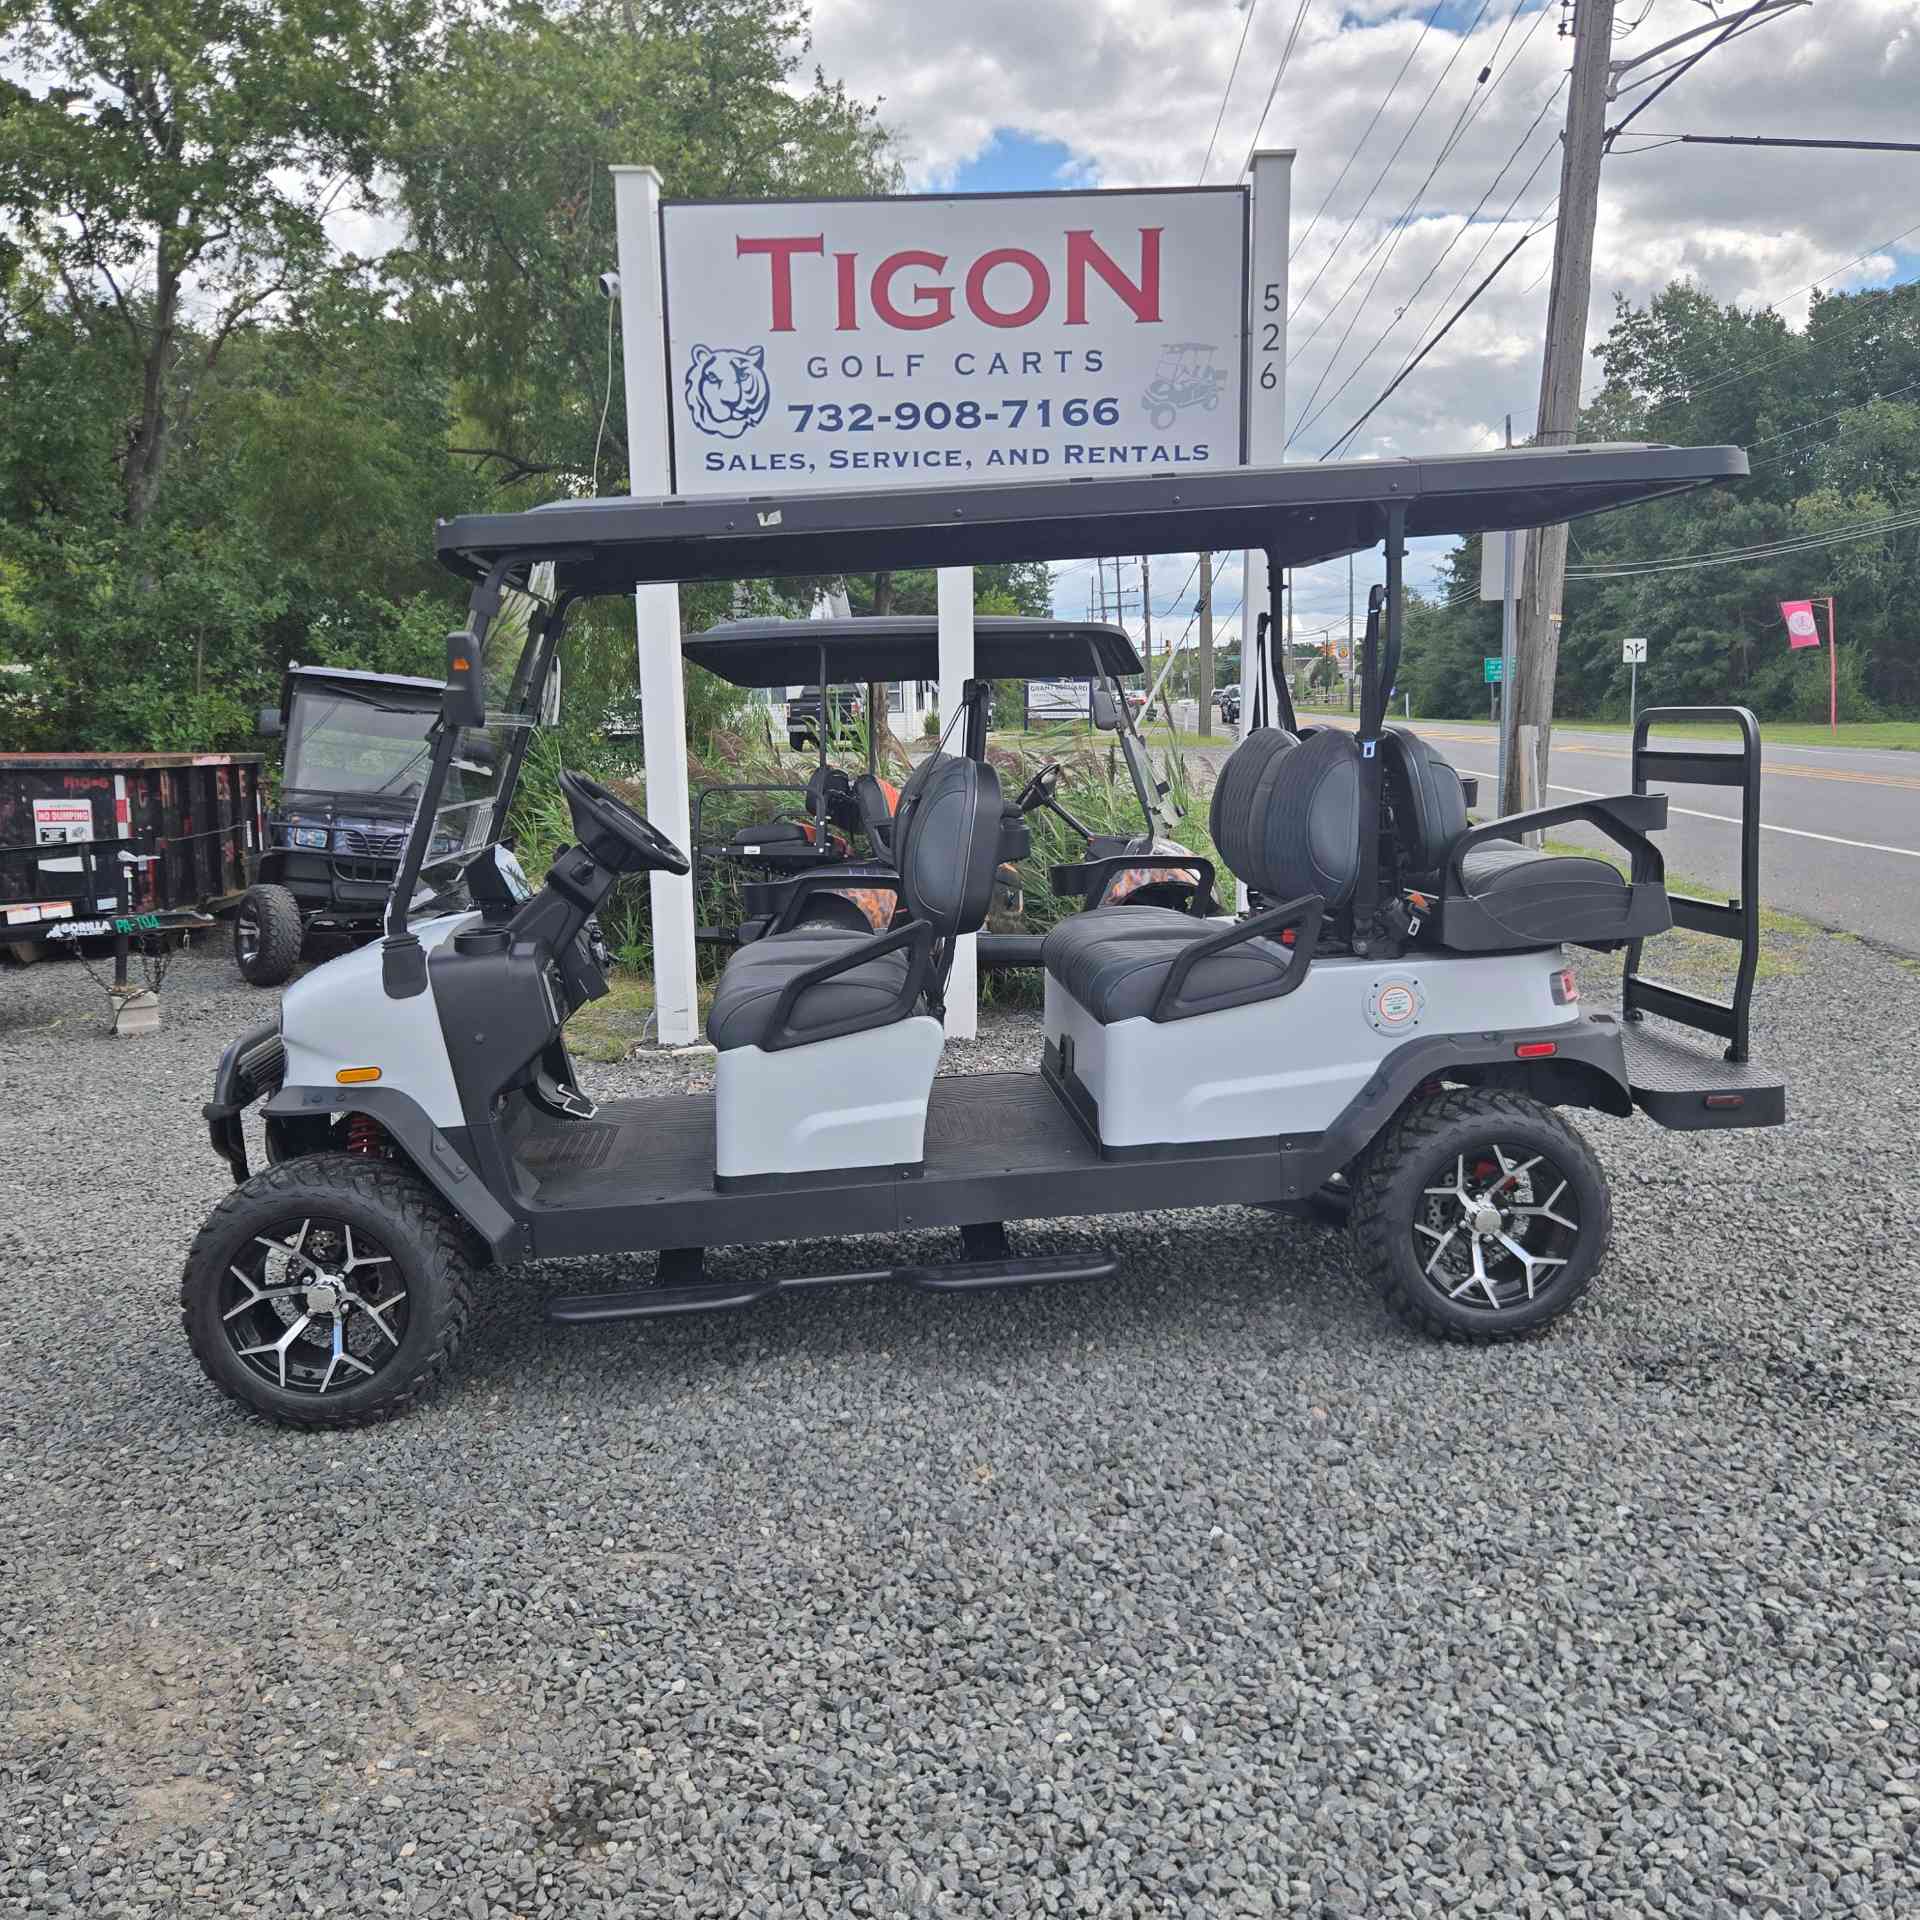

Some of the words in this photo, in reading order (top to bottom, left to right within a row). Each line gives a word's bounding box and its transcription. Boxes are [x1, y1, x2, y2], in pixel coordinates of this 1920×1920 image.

[736, 227, 1165, 333] TIGON
[807, 353, 925, 378] GOLF
[954, 350, 1104, 376] CARTS
[787, 397, 1120, 433] 732-908-7166
[705, 451, 816, 474] SALES,
[829, 449, 973, 470] SERVICE,
[986, 448, 1050, 466] AND
[1064, 444, 1210, 465] RENTALS
